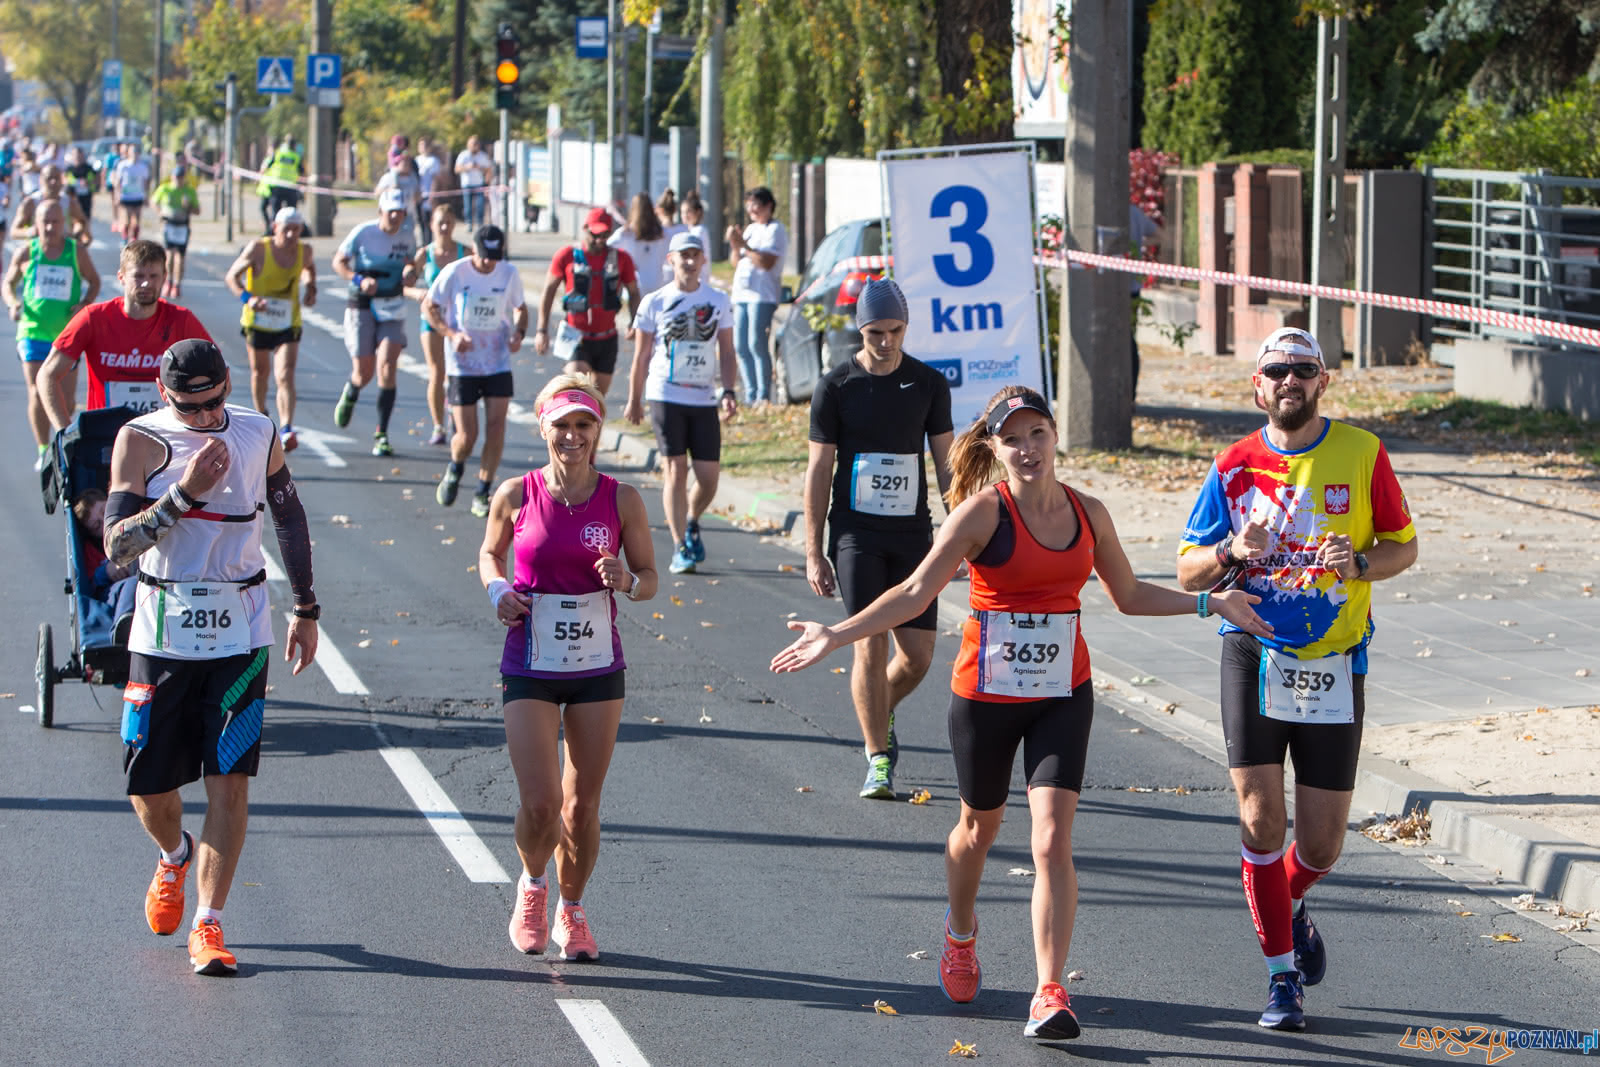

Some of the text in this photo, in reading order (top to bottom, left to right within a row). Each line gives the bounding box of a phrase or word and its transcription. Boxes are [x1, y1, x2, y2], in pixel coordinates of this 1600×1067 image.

[314, 57, 334, 84] P
[930, 184, 994, 287] 3
[931, 297, 1003, 333] km
[99, 351, 140, 368] TEAM
[685, 355, 706, 366] 734
[871, 474, 909, 491] 5291
[181, 609, 231, 628] 2816
[195, 632, 217, 640] Maciej
[554, 620, 594, 640] 554
[1002, 641, 1059, 664] 3639
[1013, 667, 1047, 675] Agnieszka
[1282, 668, 1335, 692] 3539
[1295, 694, 1320, 702] Dominik
